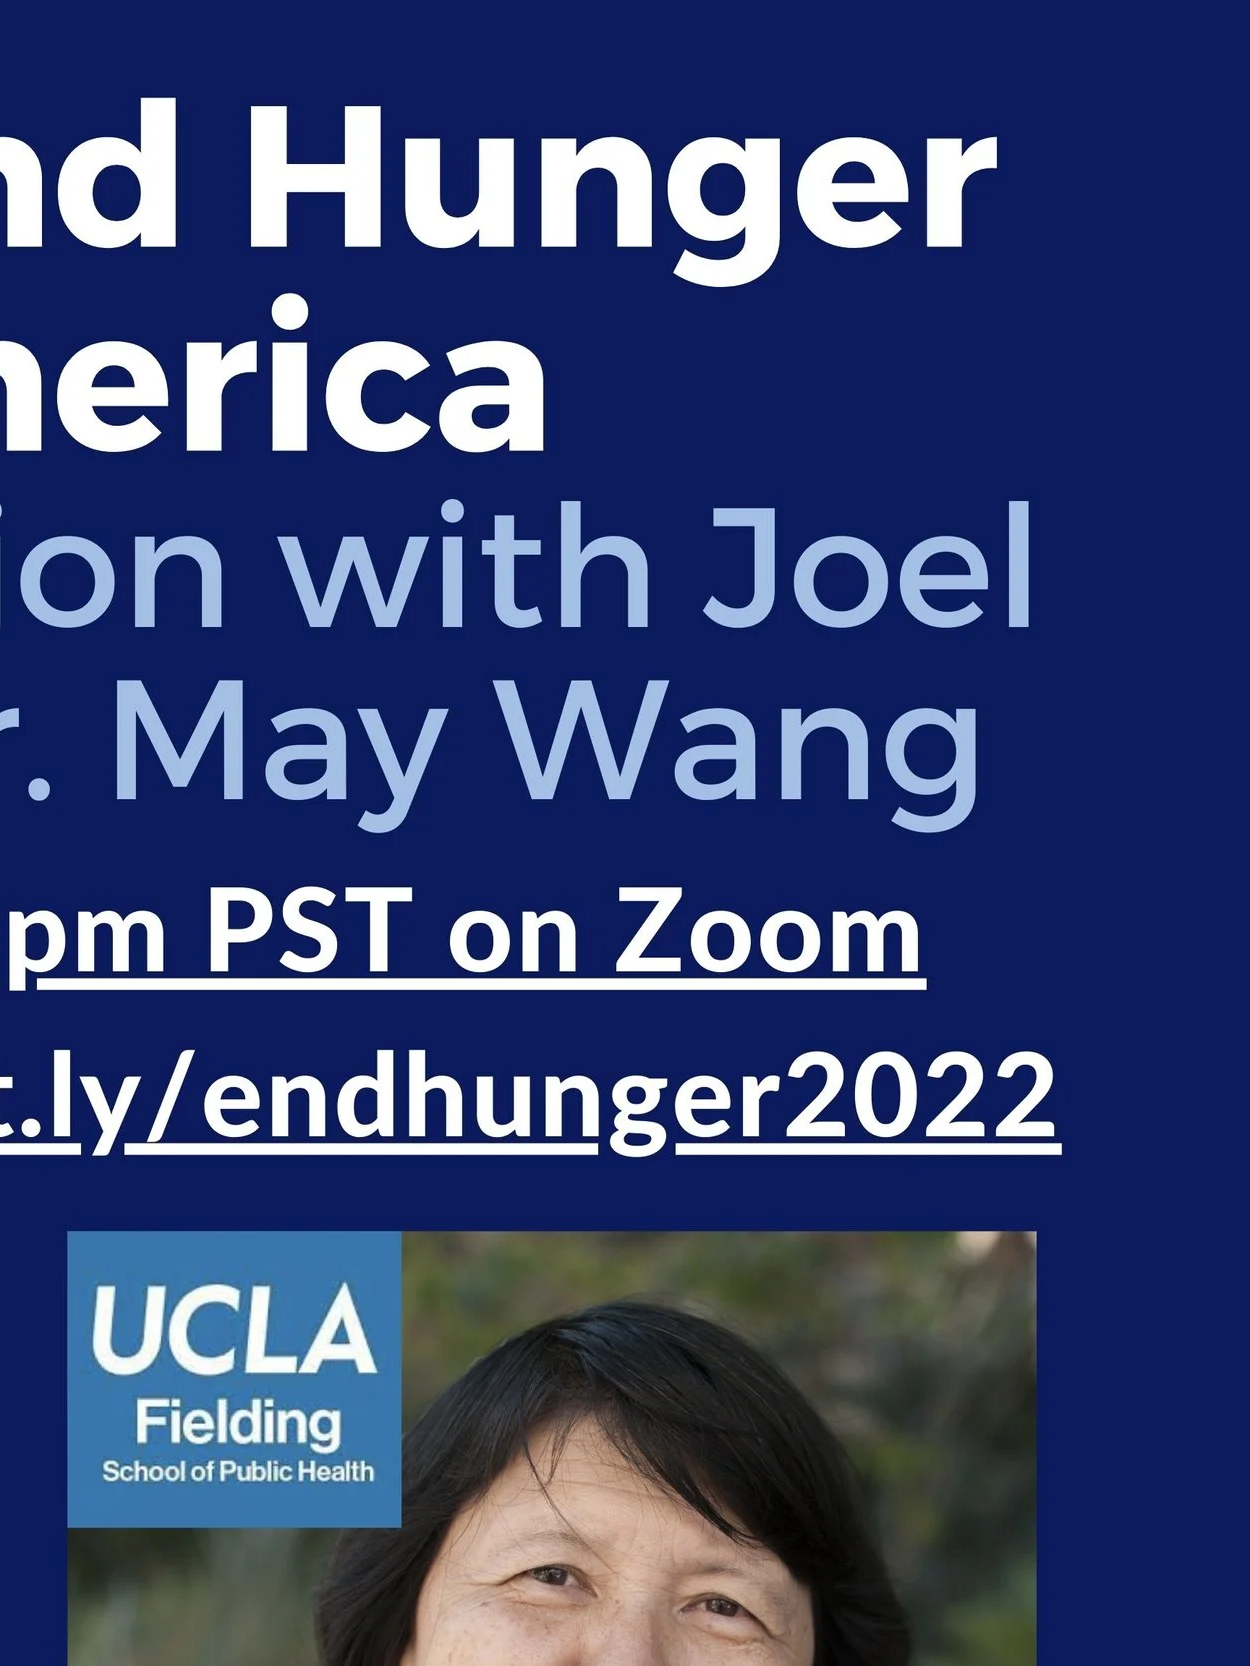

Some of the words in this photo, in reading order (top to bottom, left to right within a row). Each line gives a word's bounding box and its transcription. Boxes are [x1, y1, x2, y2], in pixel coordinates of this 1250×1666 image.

[251, 106, 997, 287] Hunger
[277, 499, 648, 628] with
[703, 501, 1029, 628] Joel
[117, 680, 449, 833] May
[493, 680, 976, 833] Wang
[9, 910, 164, 991] pm
[210, 886, 412, 973] PST
[450, 910, 576, 972] on
[616, 887, 918, 972] Zoom
[93, 1283, 377, 1375] UCLA
[103, 1461, 185, 1481] School
[191, 1461, 214, 1481] of
[220, 1461, 292, 1481] Public
[299, 1461, 374, 1481] Health
[137, 1399, 340, 1454] Fielding
